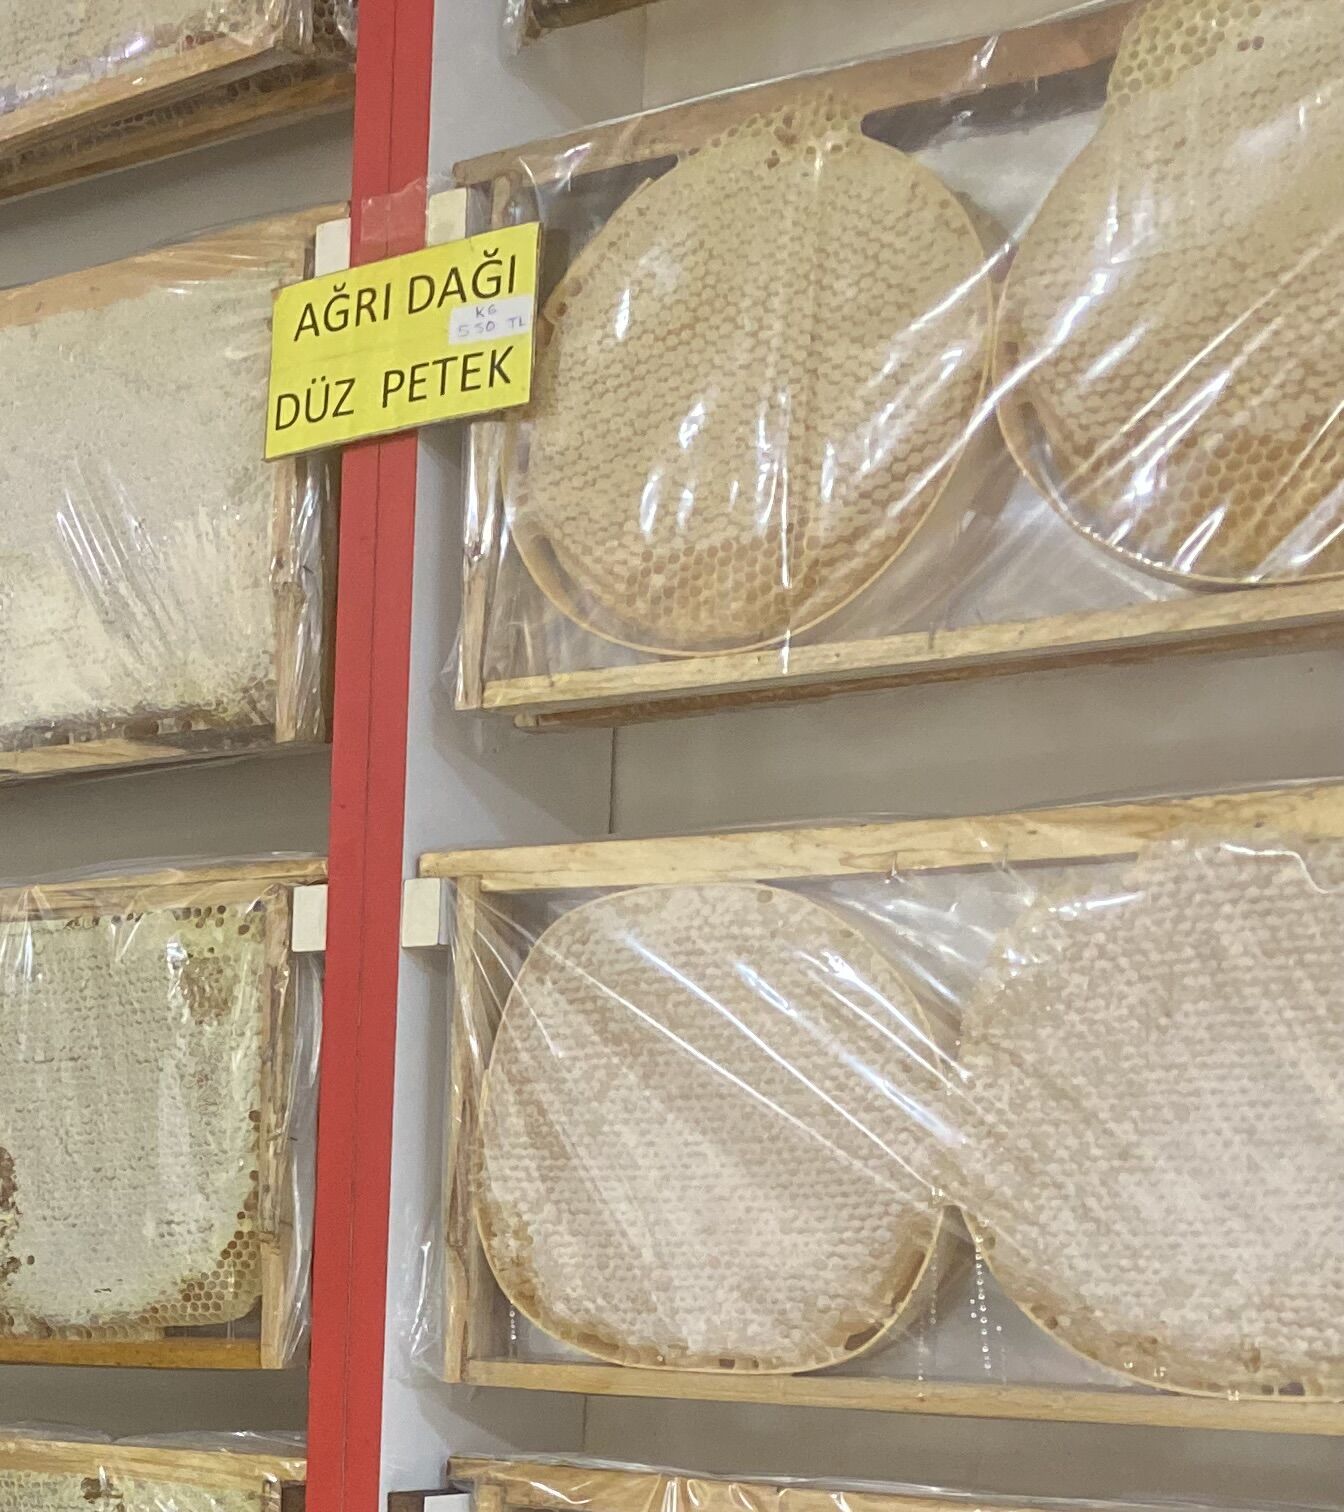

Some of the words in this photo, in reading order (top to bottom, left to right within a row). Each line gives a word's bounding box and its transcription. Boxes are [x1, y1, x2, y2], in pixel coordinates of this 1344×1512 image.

[294, 282, 392, 342] AĞRI
[408, 248, 517, 315] DAĞI
[475, 304, 497, 318] KG
[507, 316, 527, 330] TL
[275, 375, 356, 431] DÜZ
[381, 345, 515, 408] PETEK
